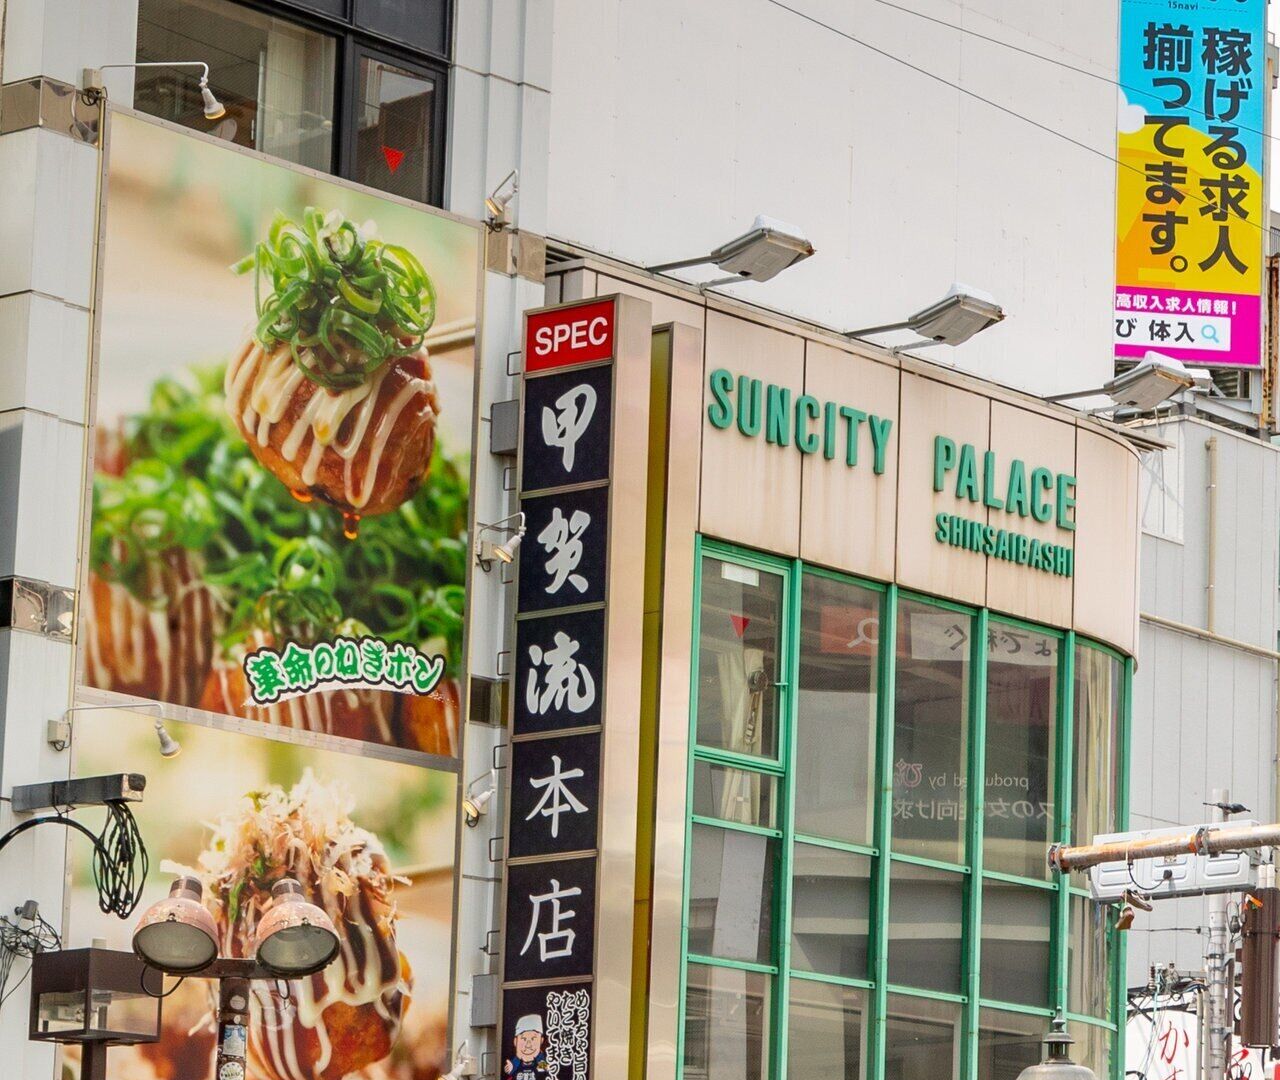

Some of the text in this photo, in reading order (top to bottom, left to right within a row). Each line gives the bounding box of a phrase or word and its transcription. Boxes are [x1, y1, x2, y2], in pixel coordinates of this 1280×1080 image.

[1142, 20, 1194, 274] 揃ってます。
[1199, 26, 1252, 276] 稼げる求人
[533, 316, 609, 358] SPEC
[1149, 319, 1196, 344] 体入
[708, 367, 893, 475] SUNCITY
[932, 434, 1077, 532] PALACE
[935, 512, 1075, 578] SHINSAIBASHI
[247, 641, 443, 702] 革命のねぎポン
[519, 383, 599, 964] 甲賀流本店
[559, 990, 576, 1066] たこ焼き
